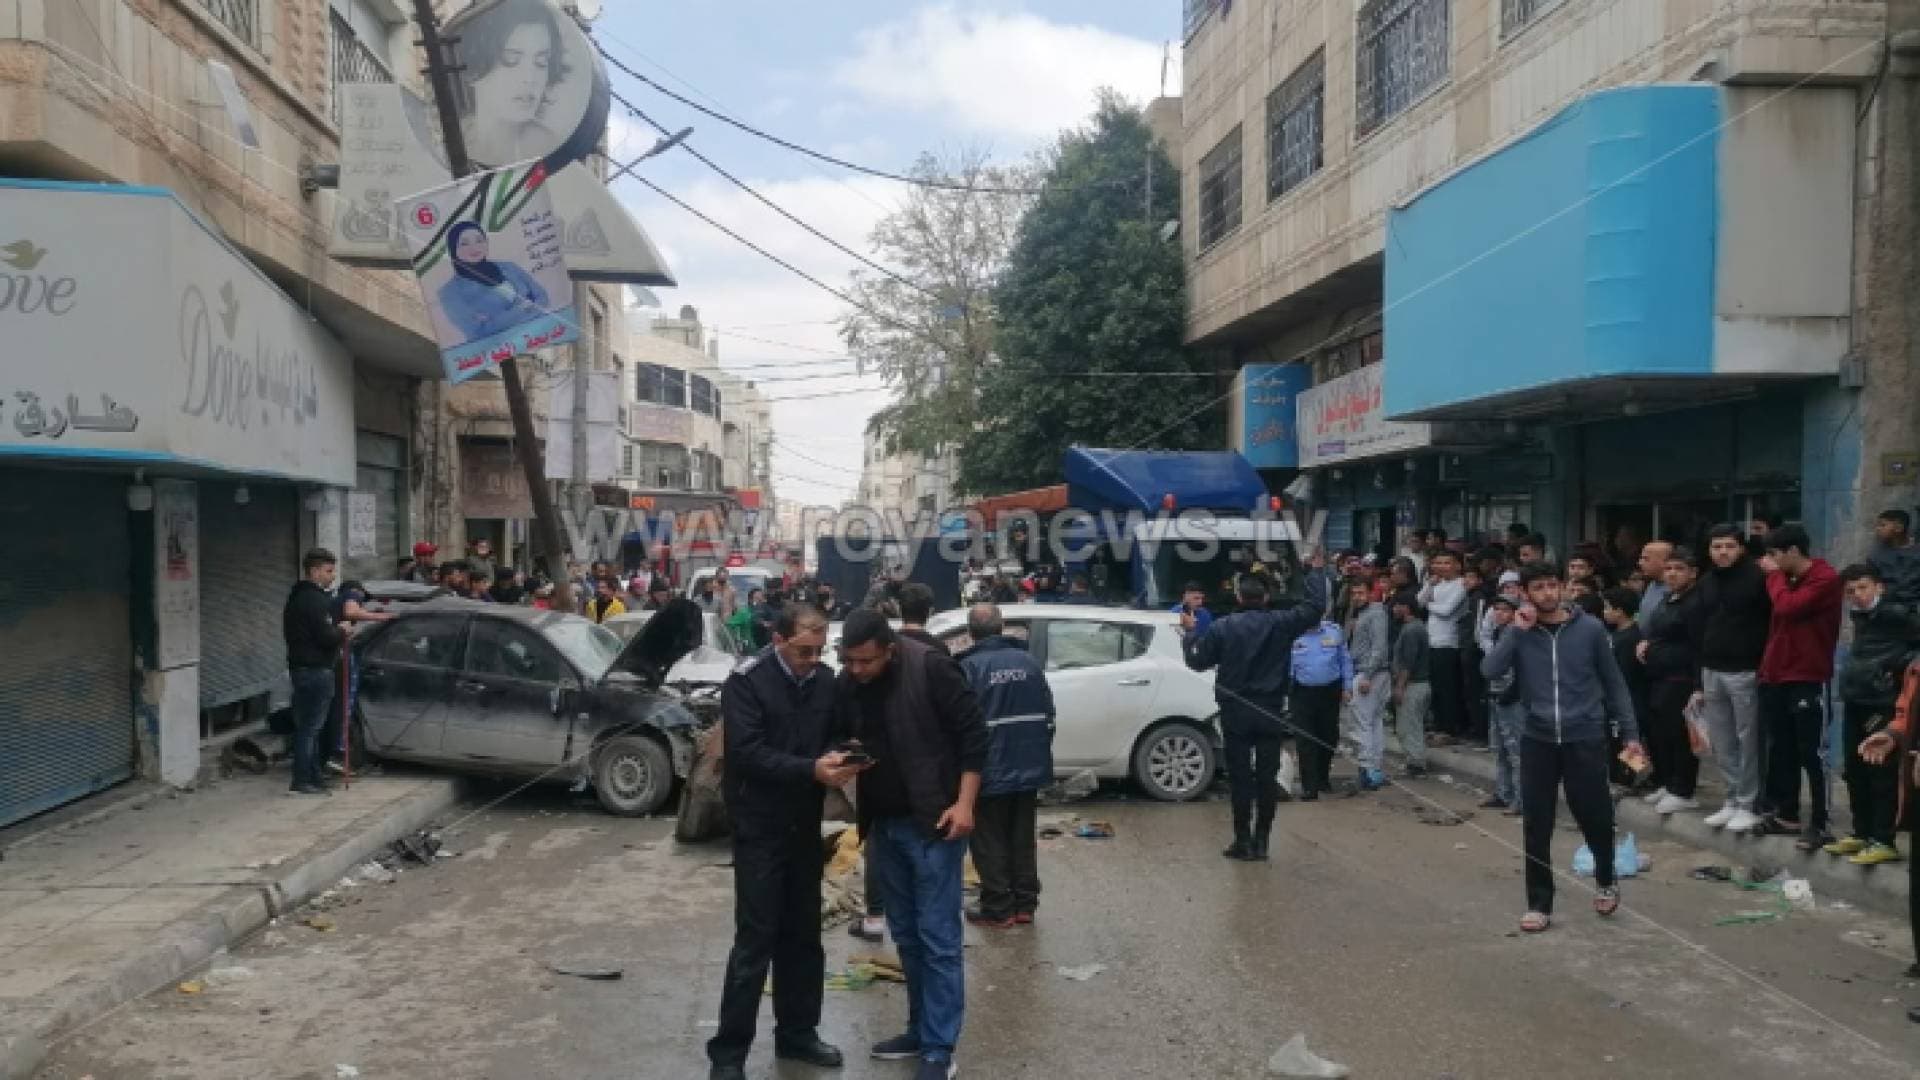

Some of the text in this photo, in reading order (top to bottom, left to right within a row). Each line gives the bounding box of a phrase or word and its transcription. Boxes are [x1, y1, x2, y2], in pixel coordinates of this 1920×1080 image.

[416, 206, 434, 226] 6
[0, 274, 77, 317] ove
[179, 283, 252, 432] Dove
